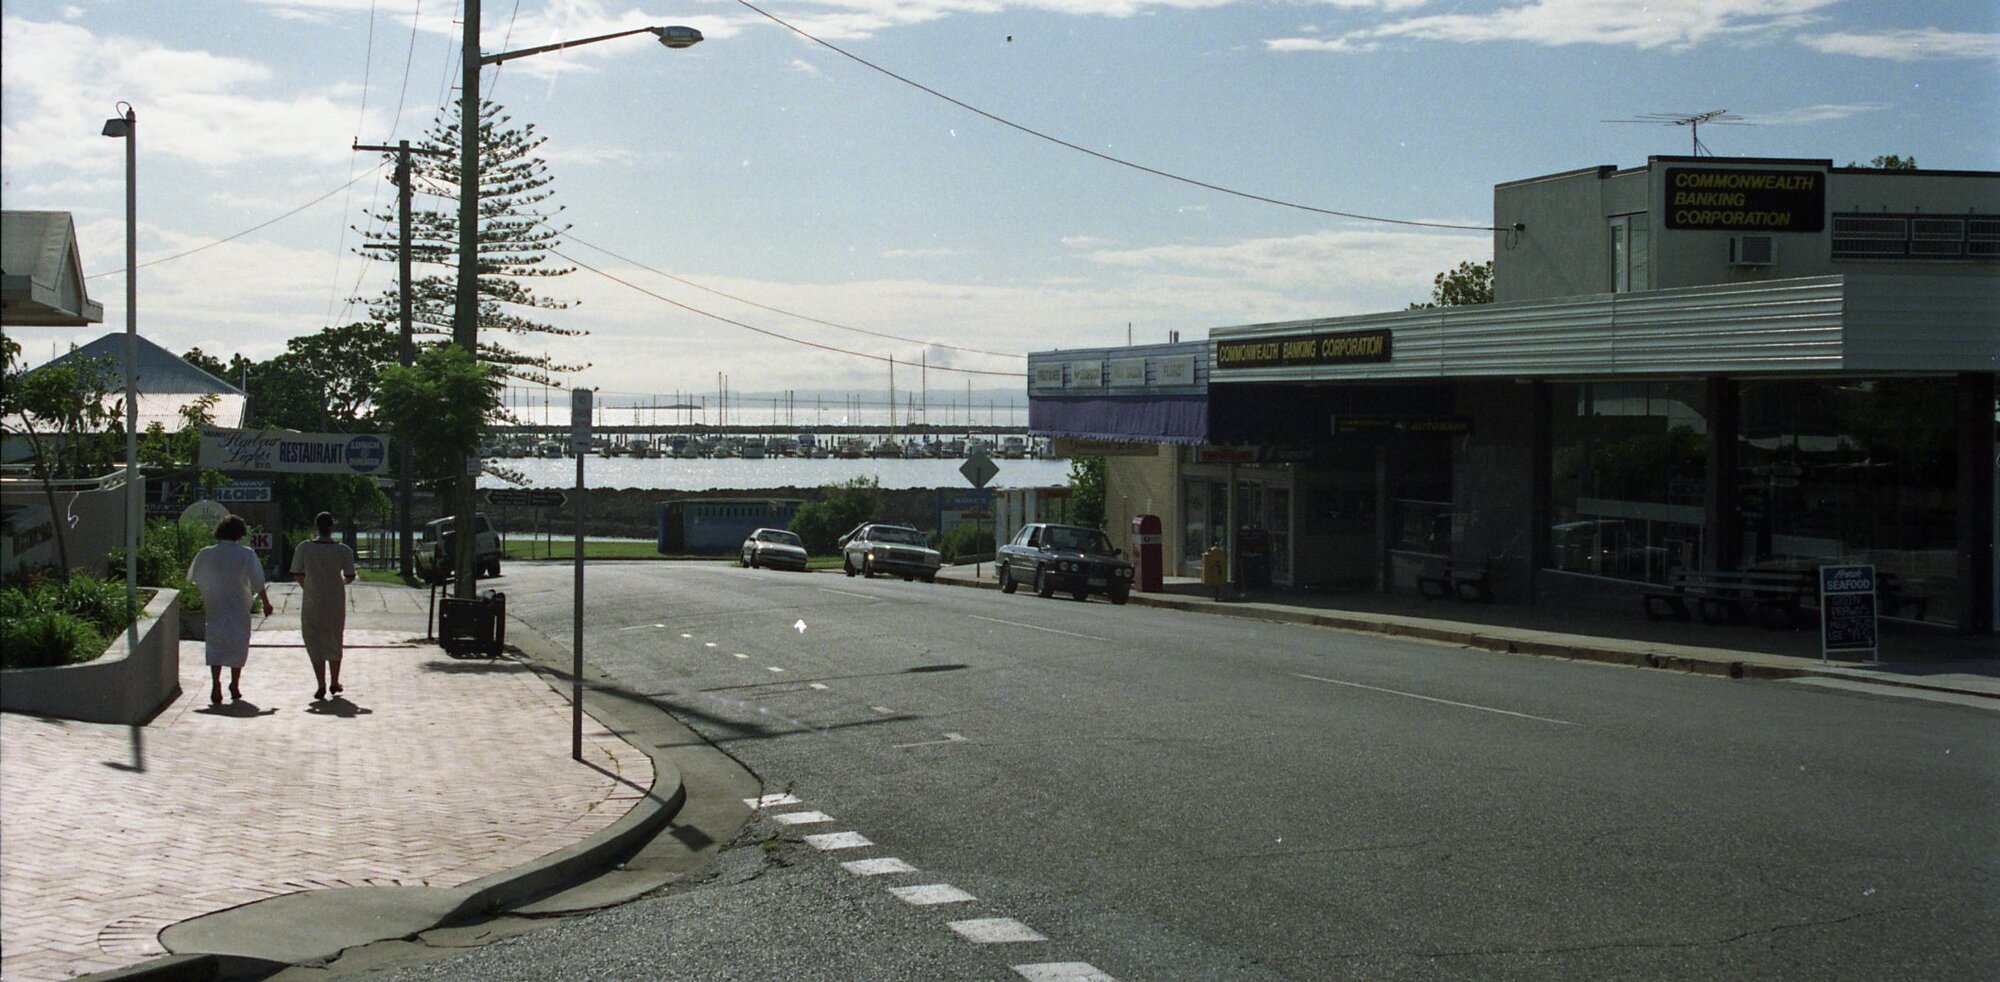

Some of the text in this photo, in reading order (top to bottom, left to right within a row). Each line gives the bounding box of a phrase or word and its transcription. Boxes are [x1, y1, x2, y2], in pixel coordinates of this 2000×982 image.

[1675, 173, 1814, 190] COMMONWEALTH
[1674, 192, 1745, 206] BANKING
[1675, 210, 1791, 225] CORPORATION
[1219, 336, 1384, 362] COMMONWEALTH BANKING CORPORATION
[217, 431, 281, 448] Harbour
[350, 441, 380, 449] LUNCH
[223, 448, 271, 468] Lights
[279, 441, 344, 464] RESTAURANT
[1827, 579, 1871, 590] SEAFOOD
